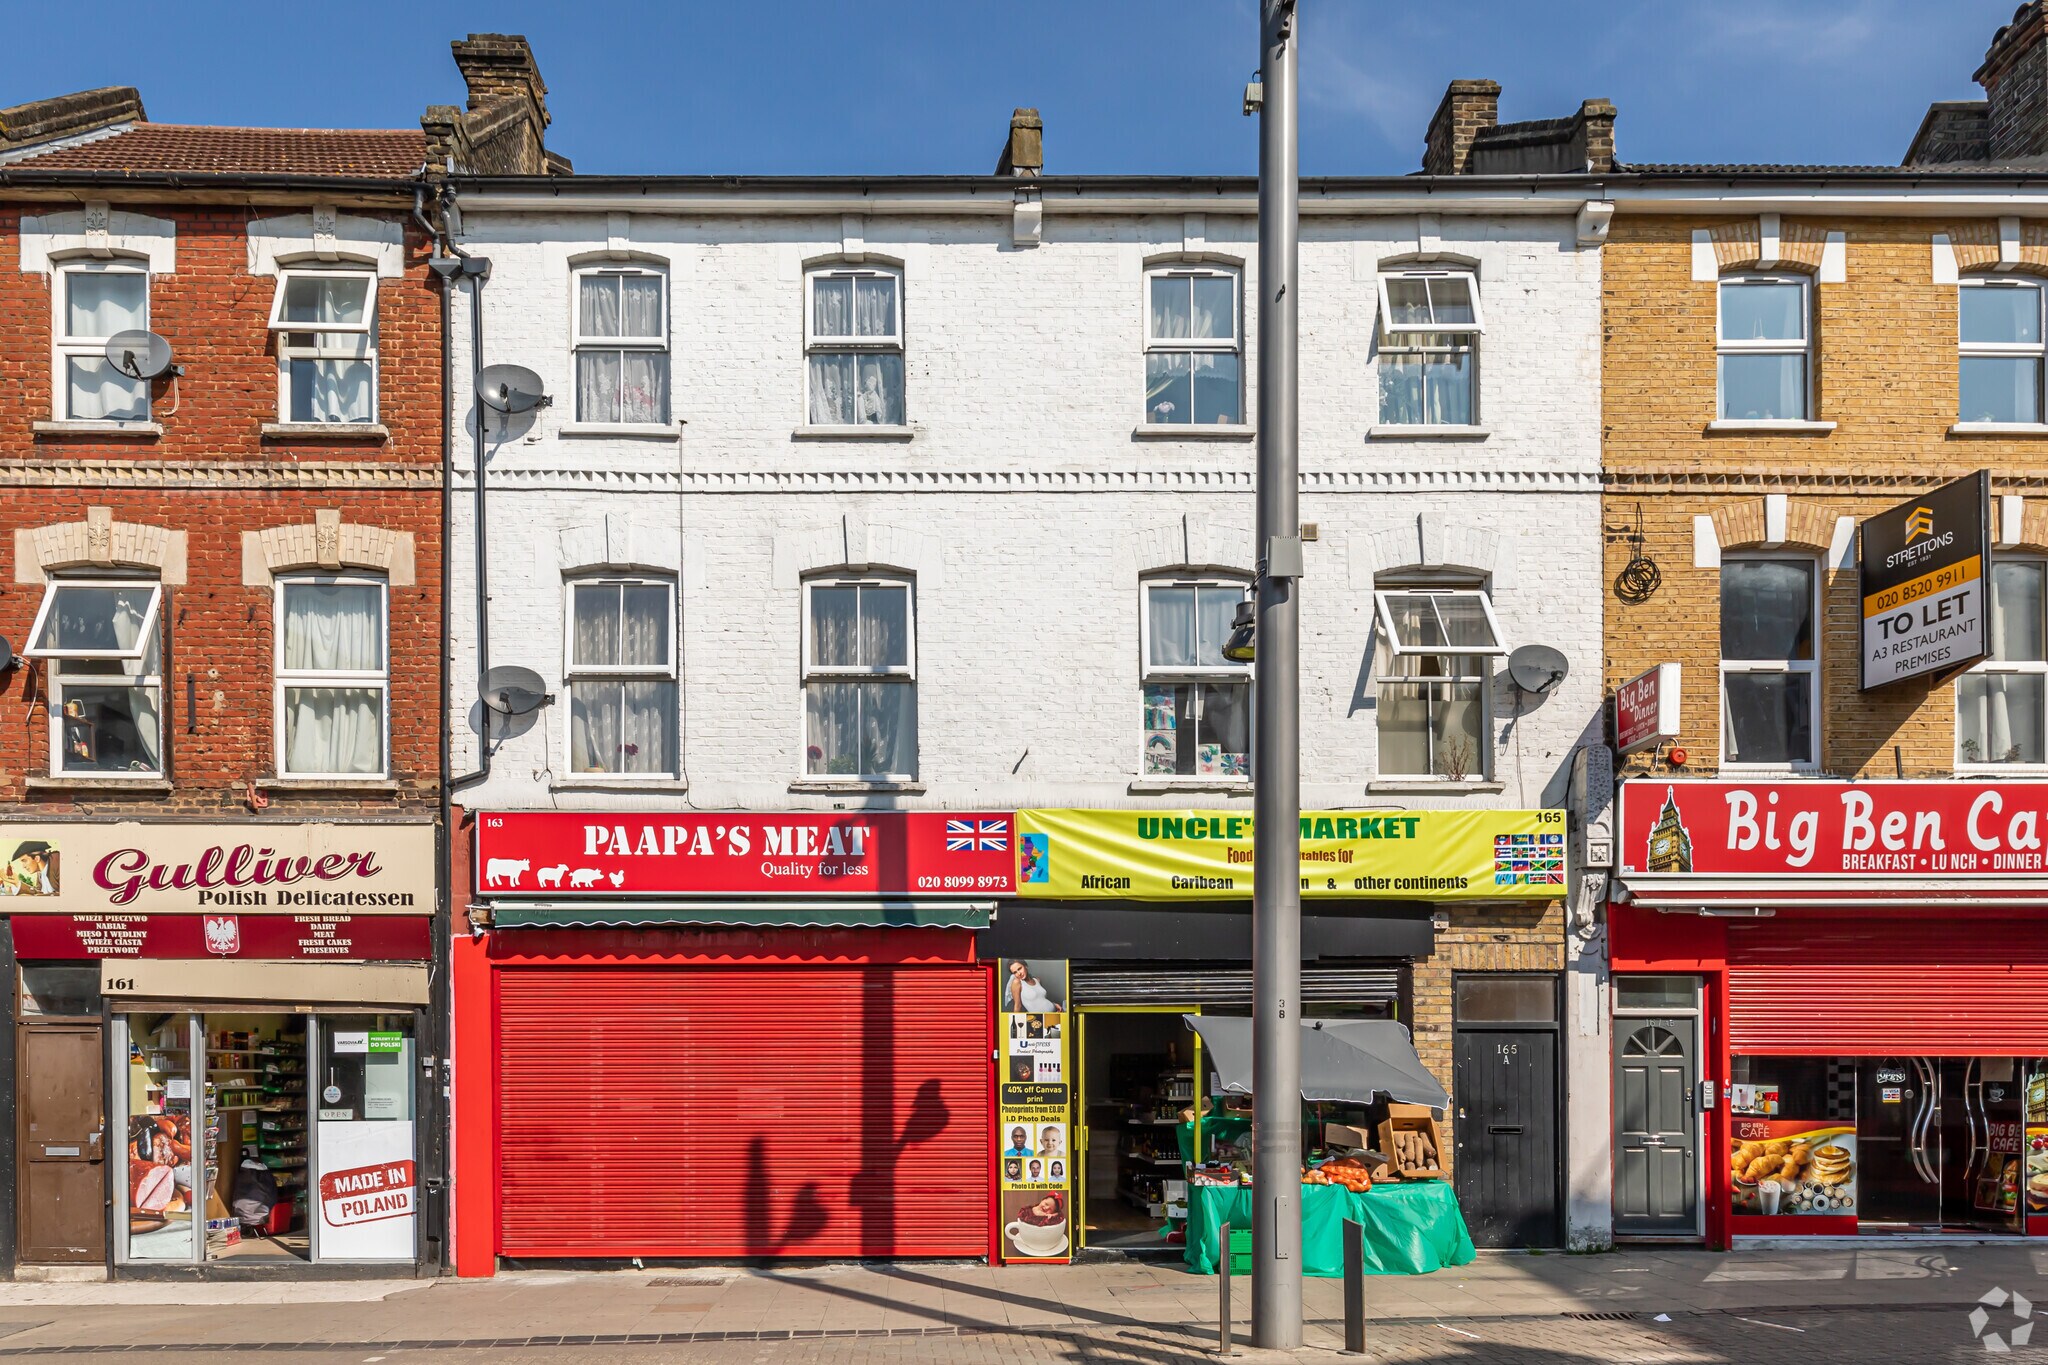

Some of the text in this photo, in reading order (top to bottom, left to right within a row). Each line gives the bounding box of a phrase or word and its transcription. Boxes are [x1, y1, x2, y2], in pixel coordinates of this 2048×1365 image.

[1886, 531, 1954, 568] STRETTONS
[1877, 565, 1965, 610] 020 8520 9911
[1877, 591, 1971, 640] TO LET
[1872, 617, 1976, 662] A3 RESTAURANT
[1895, 646, 1951, 674] PREMISES
[1620, 679, 1655, 713] Big Ben
[1634, 701, 1657, 722] Dinner
[487, 818, 503, 828] 163
[1535, 812, 1561, 823] 165
[1137, 817, 1255, 840] UNCLE'
[1725, 789, 2048, 868] Big Ben Ca
[583, 825, 870, 856] PAAPA'S MEAT
[1227, 847, 1253, 864] Food
[1338, 848, 1354, 864] for
[1842, 853, 1917, 870] BREAKFAST
[1993, 853, 2042, 870] DINNER
[93, 843, 383, 907] Gulliver
[761, 861, 869, 878] Quality for less
[918, 876, 1008, 888] 020 8099 8973
[1081, 875, 1468, 890] African Caribean & other continents
[198, 890, 414, 906] Polish Delicatessen
[294, 915, 320, 923] FRESH
[115, 938, 143, 946] CIASTA
[106, 978, 134, 990] 161
[1497, 1044, 1517, 1054] 165
[1503, 1055, 1510, 1065] A
[1740, 1125, 1770, 1137] CAFÉ
[1990, 1124, 2005, 1137] BIG
[1993, 1138, 2019, 1151] CAFE
[334, 1167, 407, 1193] MADE IN
[341, 1193, 408, 1218] POLAND
